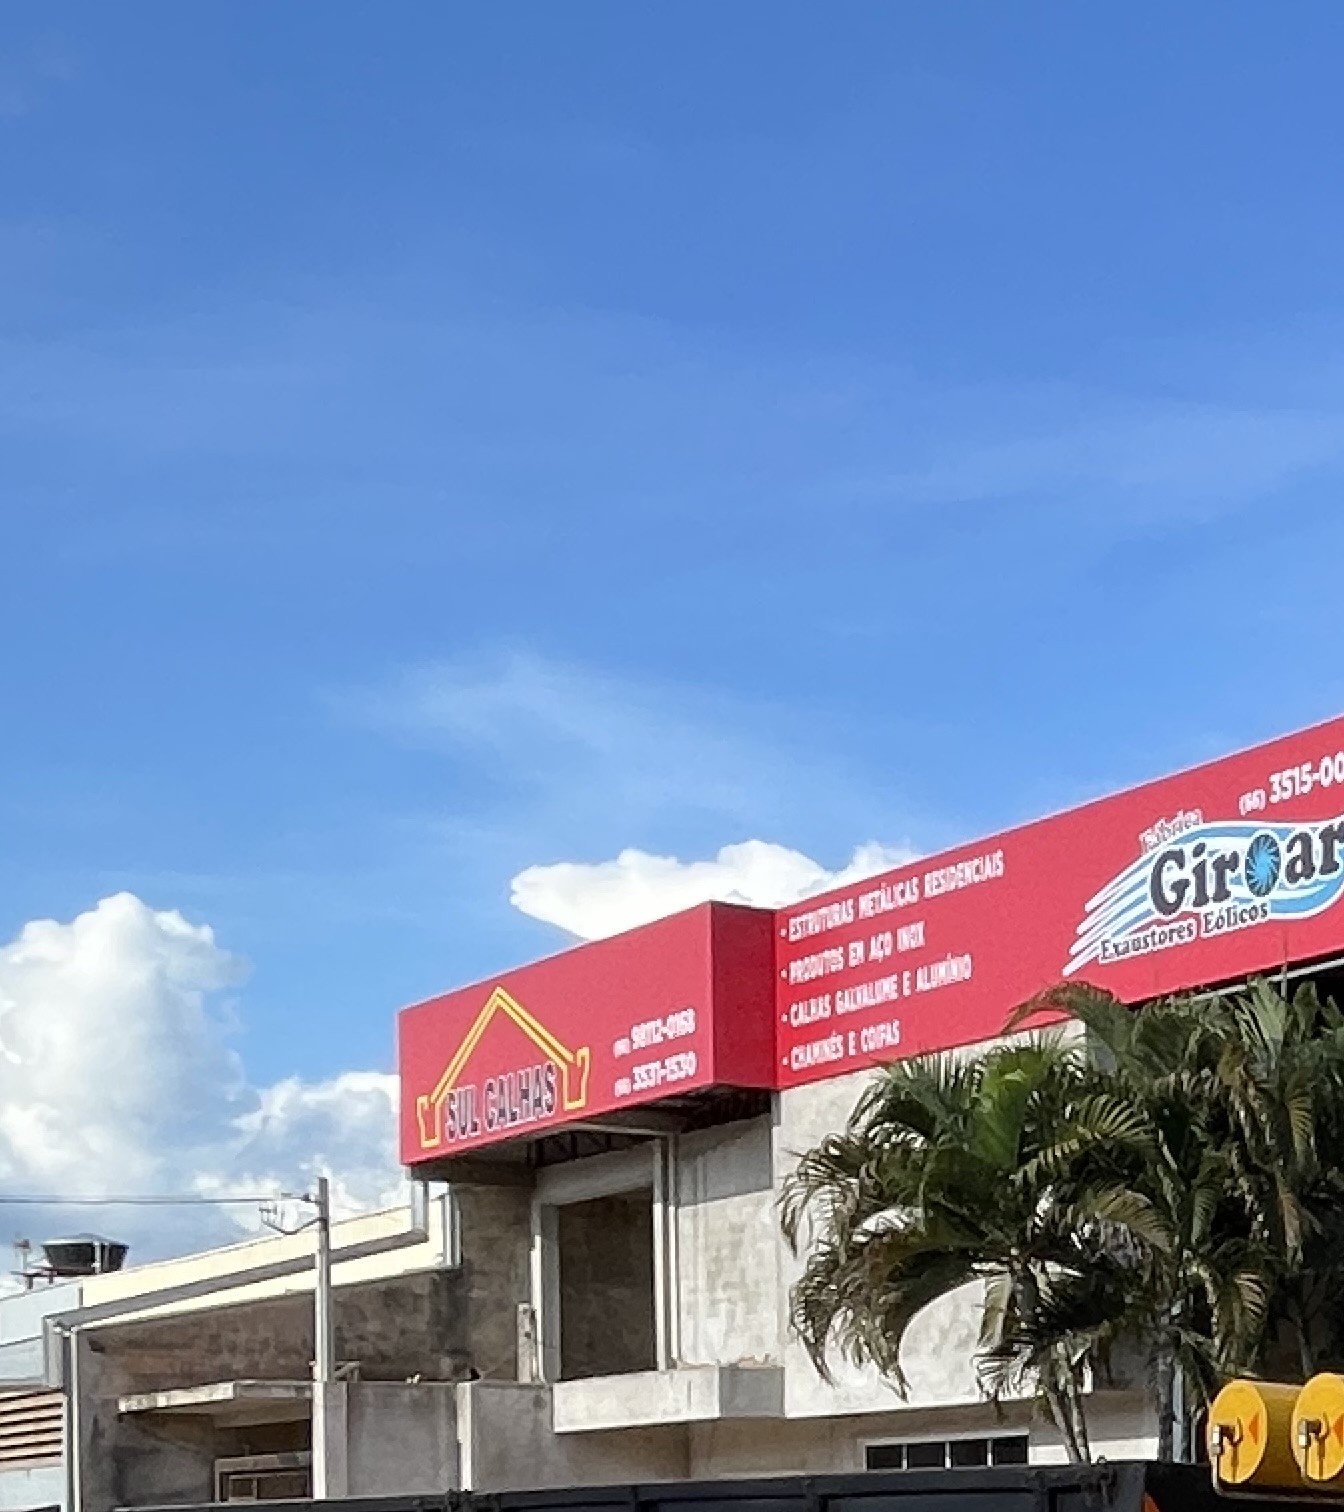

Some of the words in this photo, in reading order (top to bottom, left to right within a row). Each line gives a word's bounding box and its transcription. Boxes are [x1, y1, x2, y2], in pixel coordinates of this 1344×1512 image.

[788, 898, 854, 942] ESTRUTURAS
[858, 876, 920, 920] METÁLICAS
[924, 848, 1005, 898] RESIDENCIAIS
[788, 946, 844, 986] PRODUTOS
[868, 930, 892, 963] AÇO
[897, 920, 926, 953] INOX
[1100, 920, 1195, 962] Exaustores
[1203, 902, 1269, 935] Eólicos
[790, 994, 832, 1028] CALHAS
[902, 970, 912, 997] E
[916, 952, 973, 992] ALUMÍNIO
[848, 1029, 857, 1056] E
[860, 1019, 901, 1059] COIFAS
[446, 1085, 480, 1142] SUL
[483, 1060, 558, 1131] CALHAS
